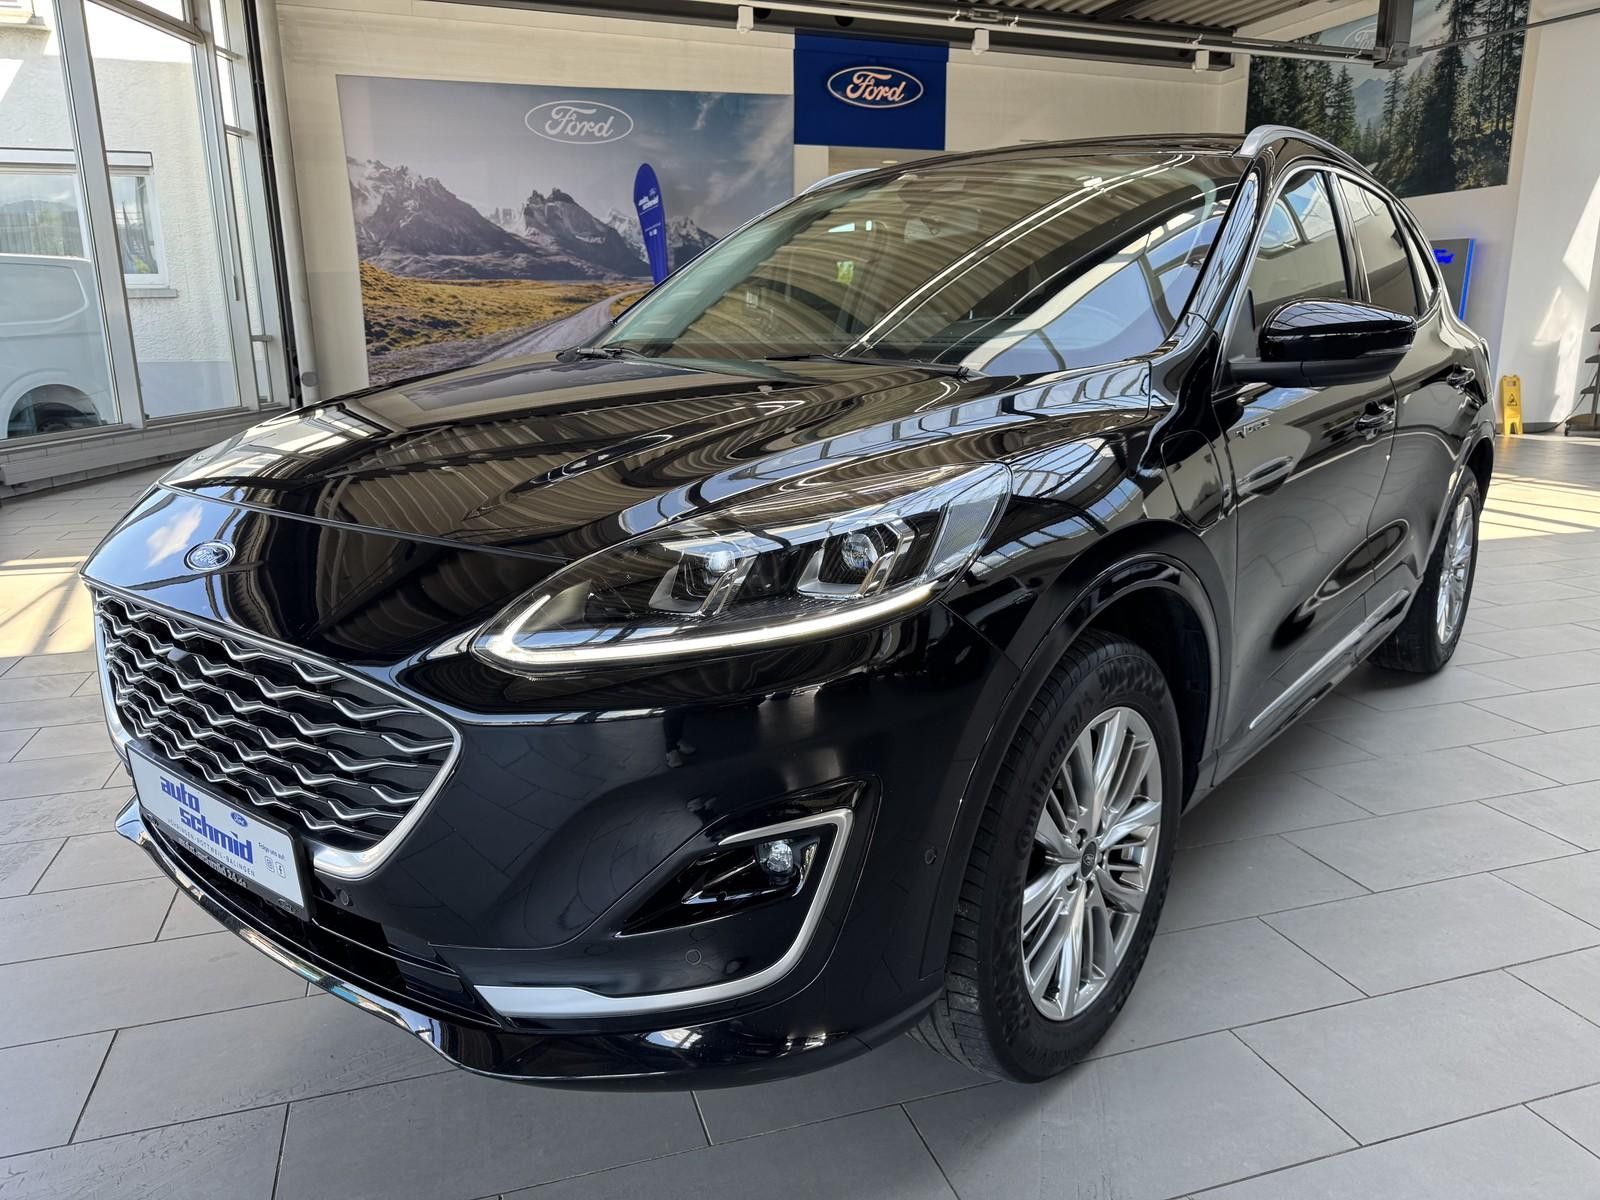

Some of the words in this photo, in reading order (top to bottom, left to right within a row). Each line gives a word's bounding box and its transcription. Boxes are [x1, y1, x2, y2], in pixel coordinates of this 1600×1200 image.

[846, 71, 906, 101] Ford
[545, 105, 614, 137] Ford
[160, 776, 200, 813] auto
[179, 807, 253, 864] schmid
